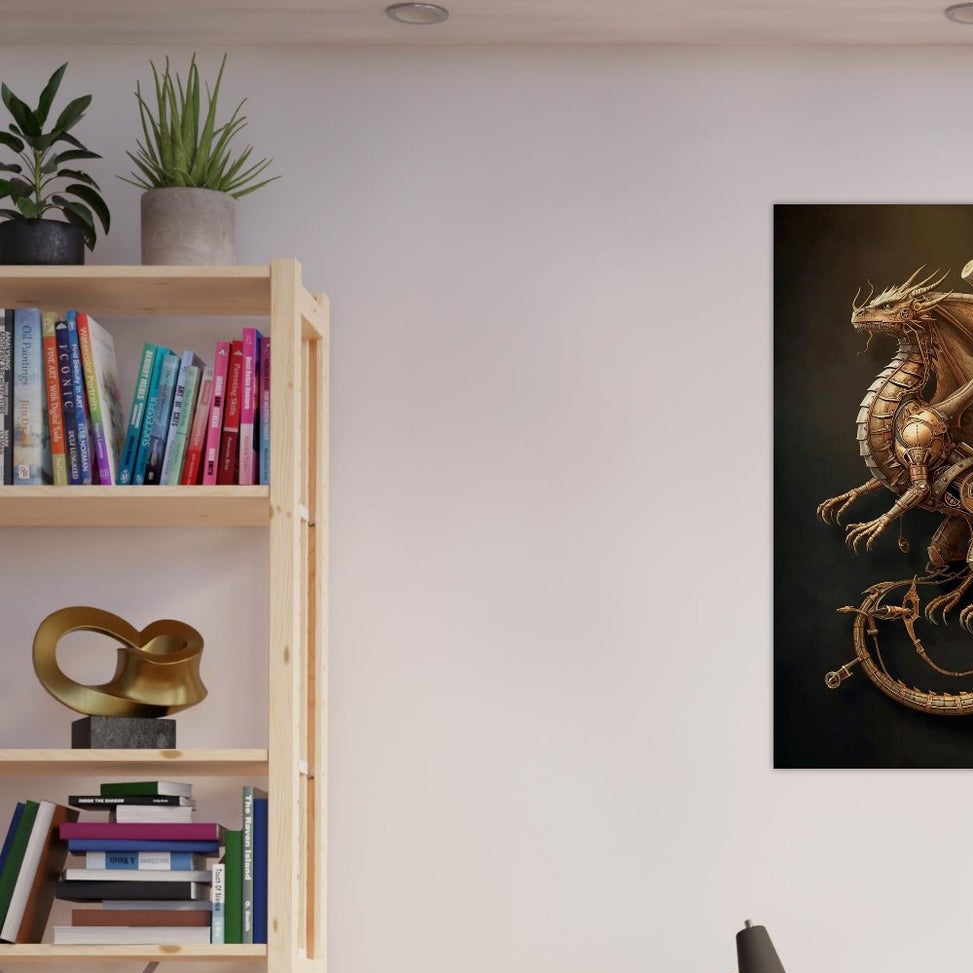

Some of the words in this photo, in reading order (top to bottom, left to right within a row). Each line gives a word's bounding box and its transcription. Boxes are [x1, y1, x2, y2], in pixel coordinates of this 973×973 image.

[21, 325, 32, 340] Oil
[18, 341, 32, 386] Paintings
[47, 347, 55, 361] FINE
[80, 326, 91, 373] Watercolor
[48, 362, 56, 379] ART
[59, 344, 73, 408] ICONIC
[230, 363, 241, 397] Parenting
[85, 375, 97, 411] Portraits
[229, 397, 238, 415] Skills
[244, 817, 252, 847] Raven
[214, 869, 222, 884] Touch
[244, 850, 252, 881] Island
